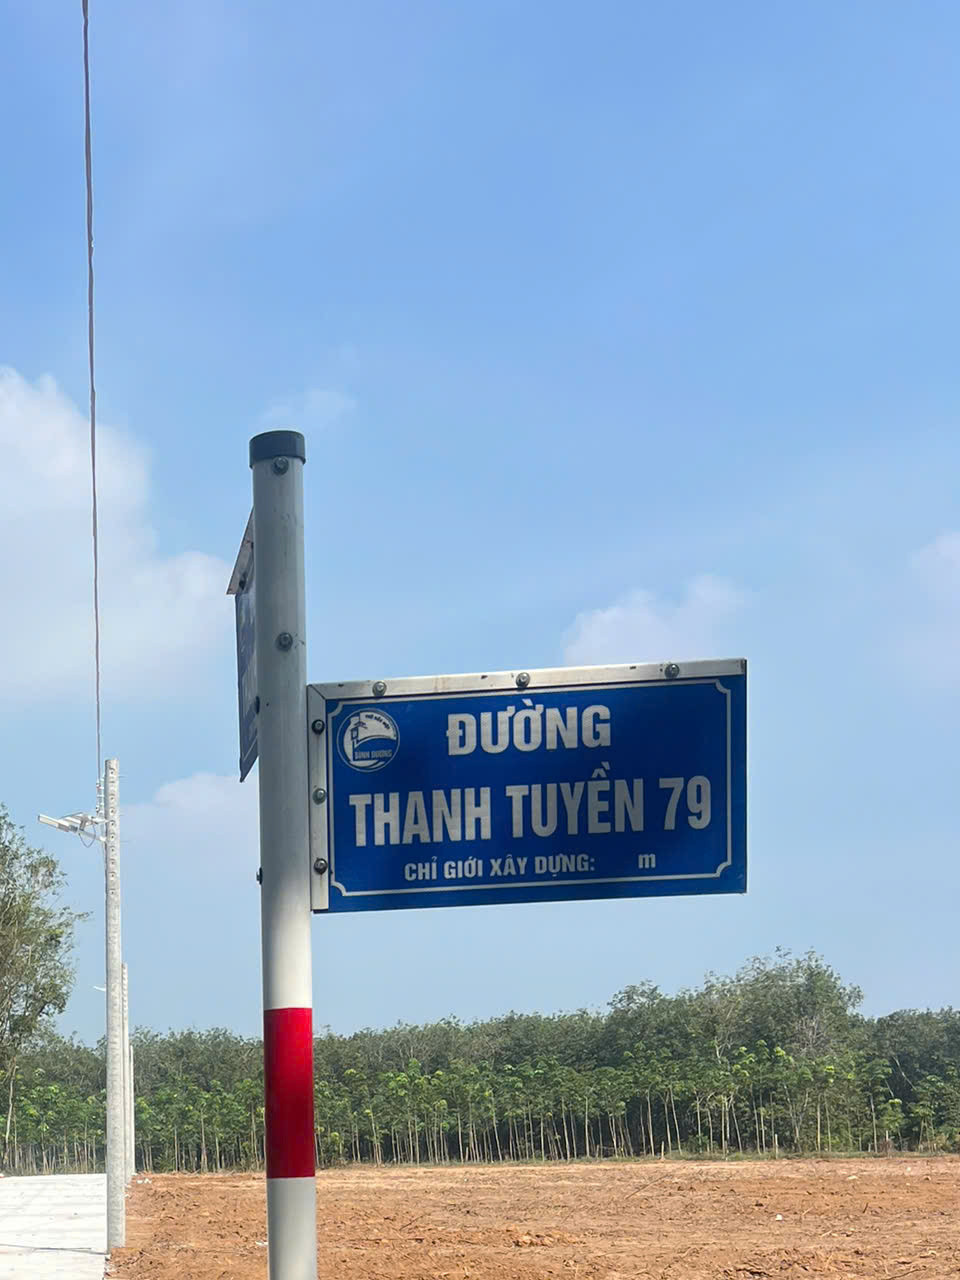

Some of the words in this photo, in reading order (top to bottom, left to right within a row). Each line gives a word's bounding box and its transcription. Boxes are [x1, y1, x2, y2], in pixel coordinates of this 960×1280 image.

[446, 699, 611, 756] ĐƯỜNG
[348, 786, 492, 847] THANH
[505, 761, 644, 838] TUYỀN
[658, 775, 711, 831] 79
[404, 856, 438, 881] CHỈ
[443, 856, 483, 879] GIỚI
[489, 854, 528, 877] XÂY
[534, 853, 595, 877] DỰNG:
[638, 853, 656, 869] m
